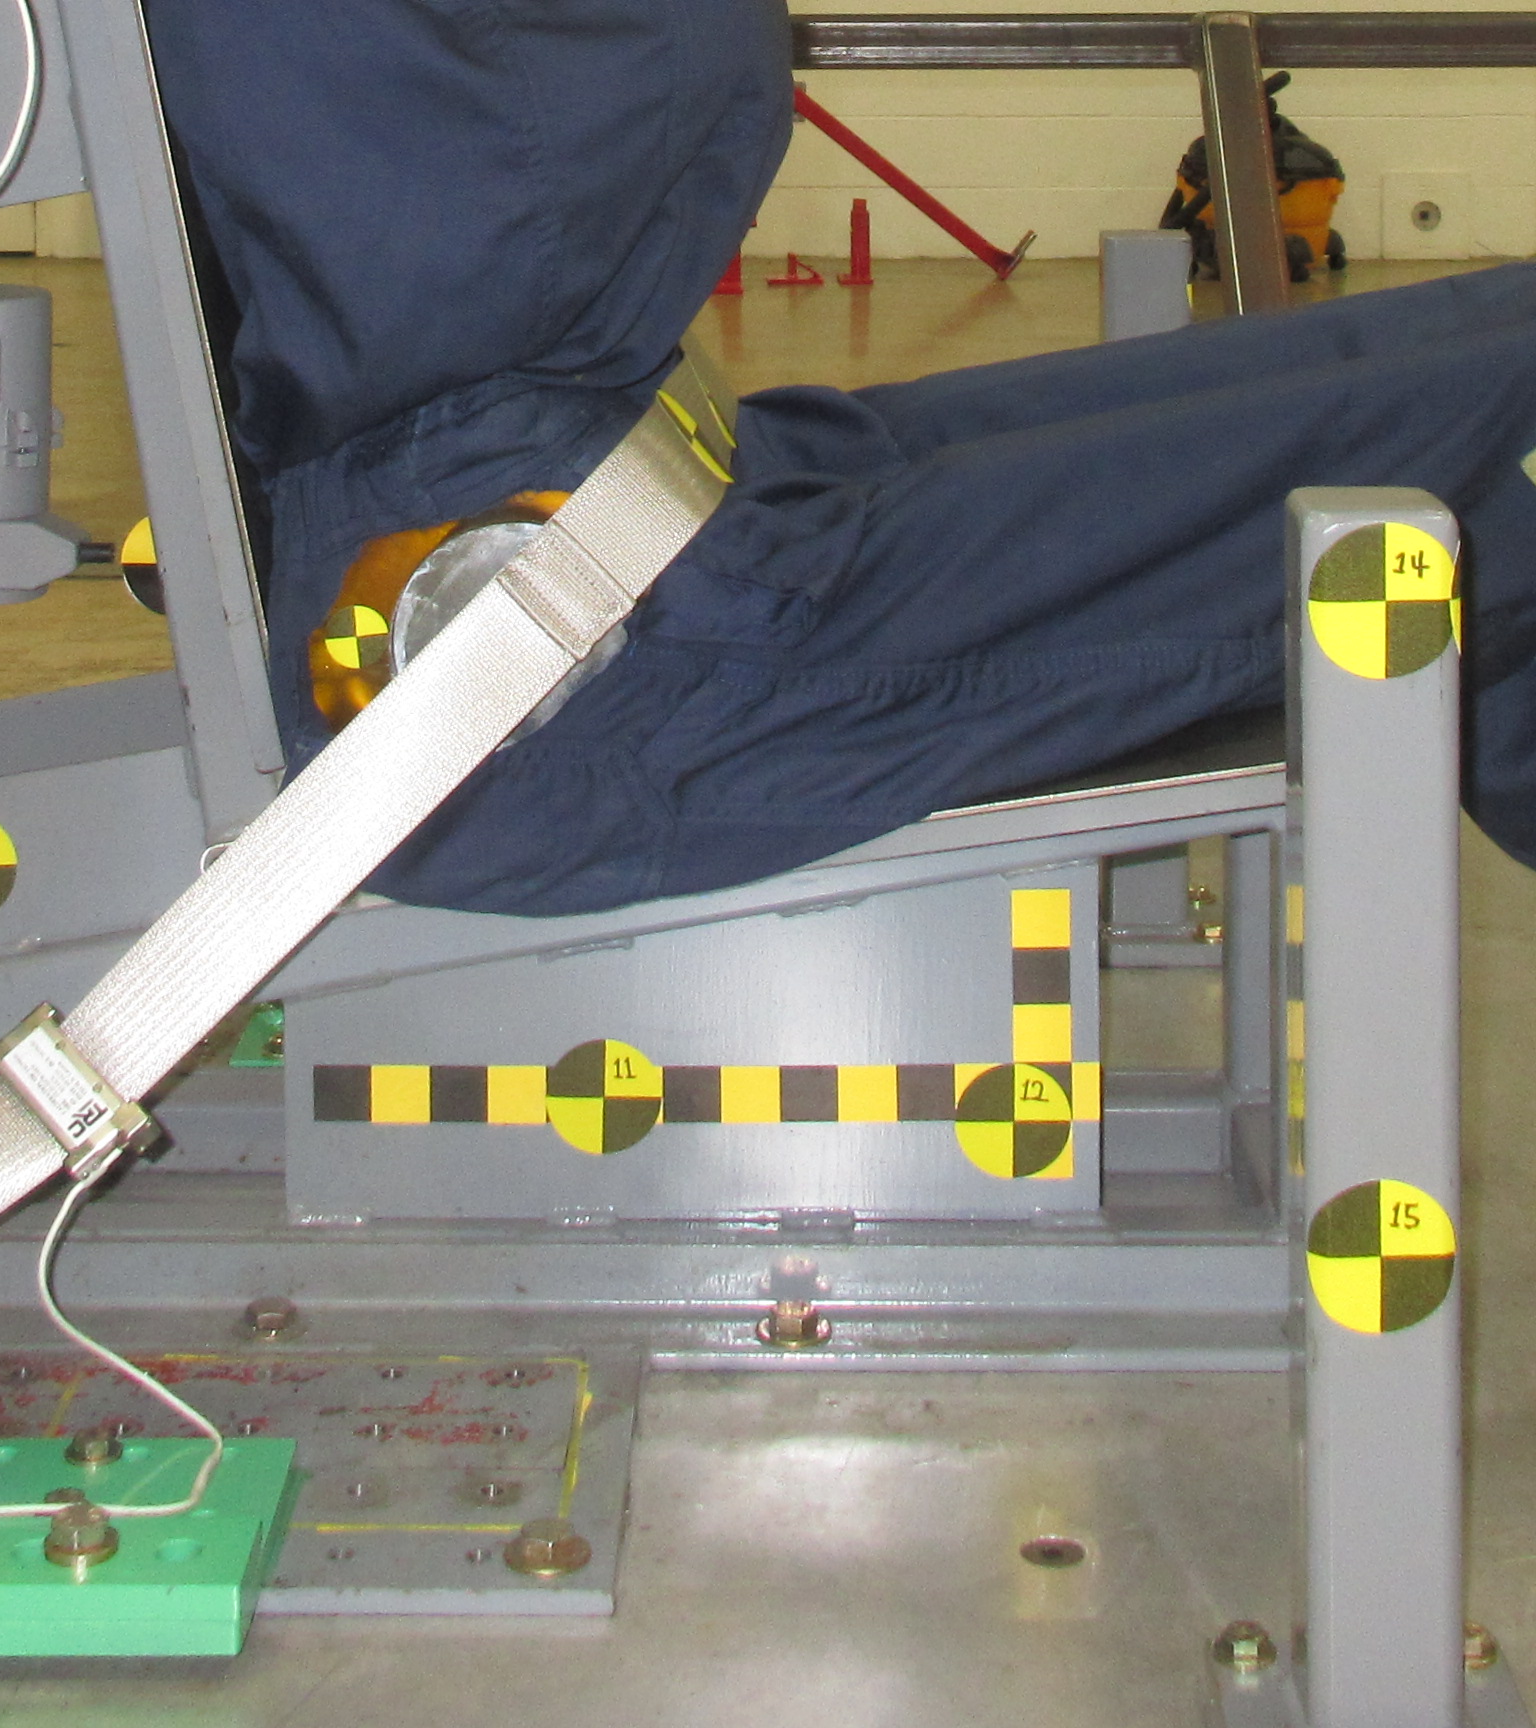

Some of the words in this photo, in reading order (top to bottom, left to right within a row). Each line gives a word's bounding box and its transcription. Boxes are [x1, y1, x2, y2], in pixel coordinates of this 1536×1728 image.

[1393, 549, 1432, 580] 14
[613, 1057, 637, 1080] 11
[1018, 1079, 1048, 1103] 12
[67, 1100, 109, 1139] TRC
[1389, 1201, 1421, 1231] 15
